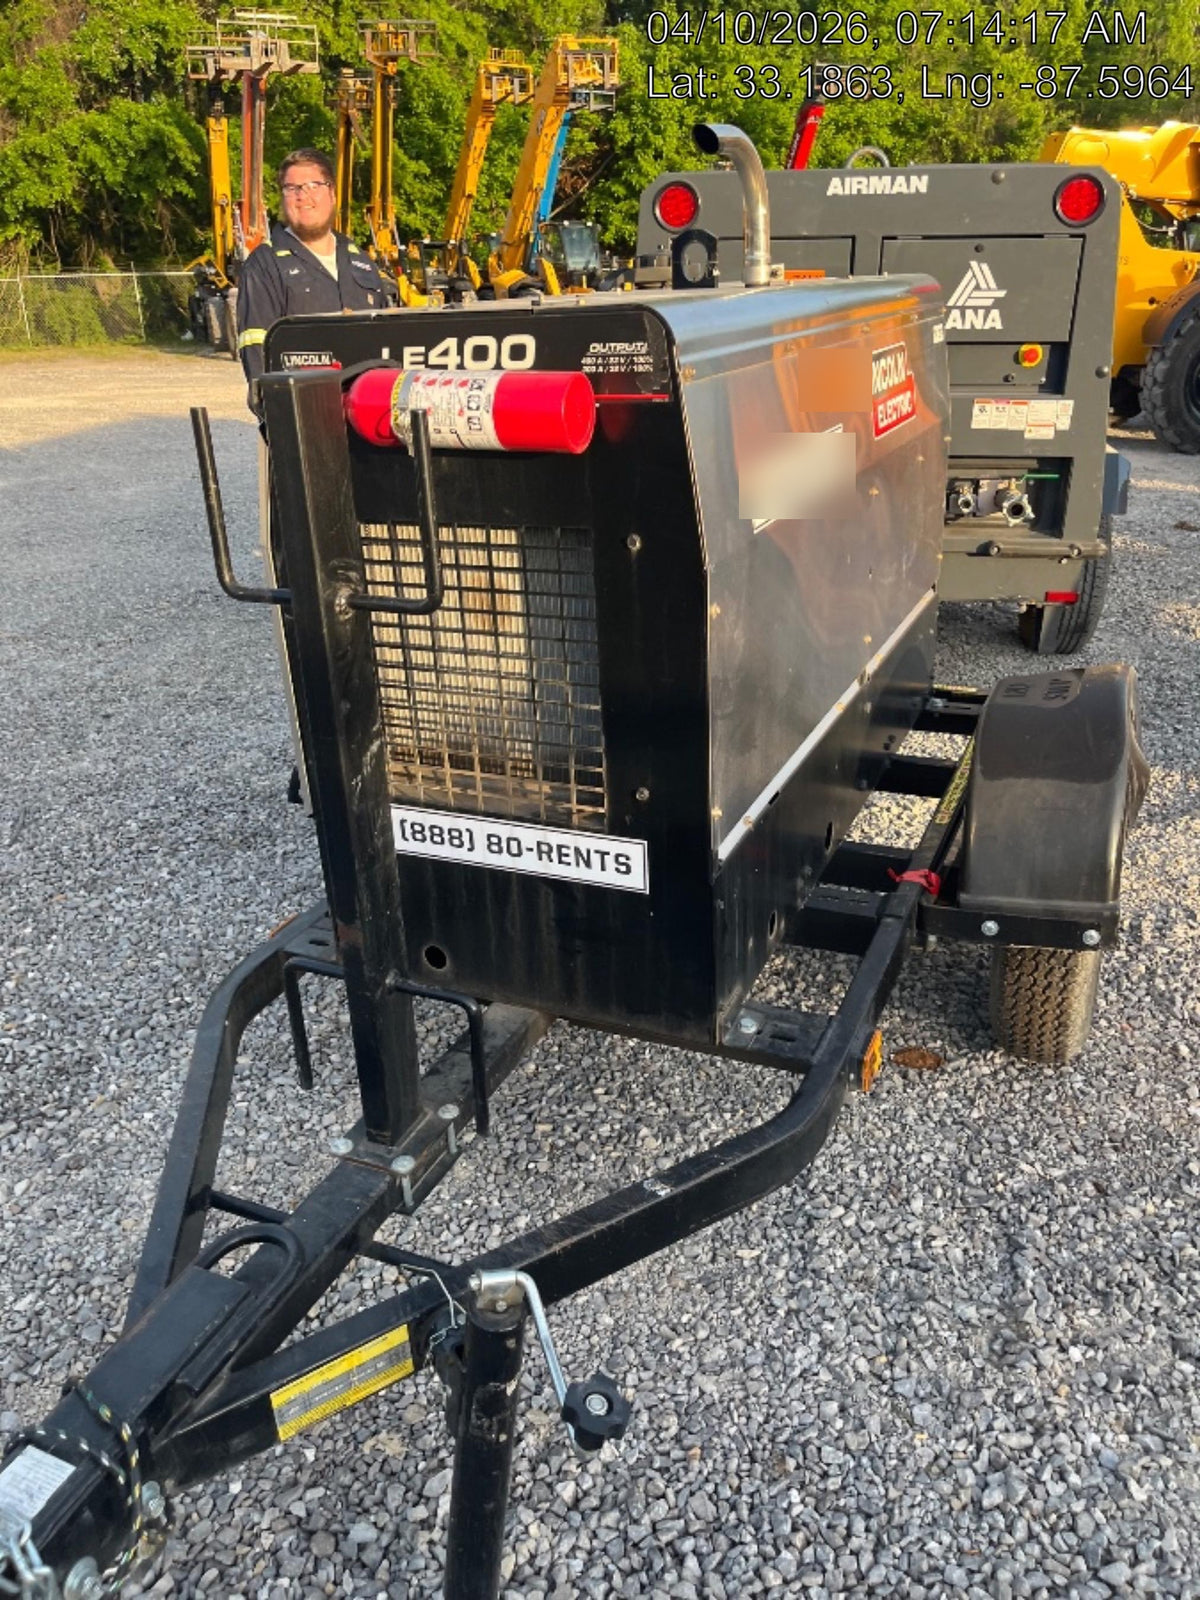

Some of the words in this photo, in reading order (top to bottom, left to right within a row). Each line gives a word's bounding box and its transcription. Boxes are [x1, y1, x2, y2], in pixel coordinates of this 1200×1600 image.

[826, 175, 929, 196] AIRMAN
[944, 309, 1004, 330] ANA
[589, 342, 642, 353] OUTPUT
[284, 354, 331, 367] LINCOLN
[872, 351, 906, 395] NCOLN
[878, 391, 913, 429] ELECTRIC
[399, 818, 476, 852] (888)
[486, 833, 632, 876] 80-RENTS
